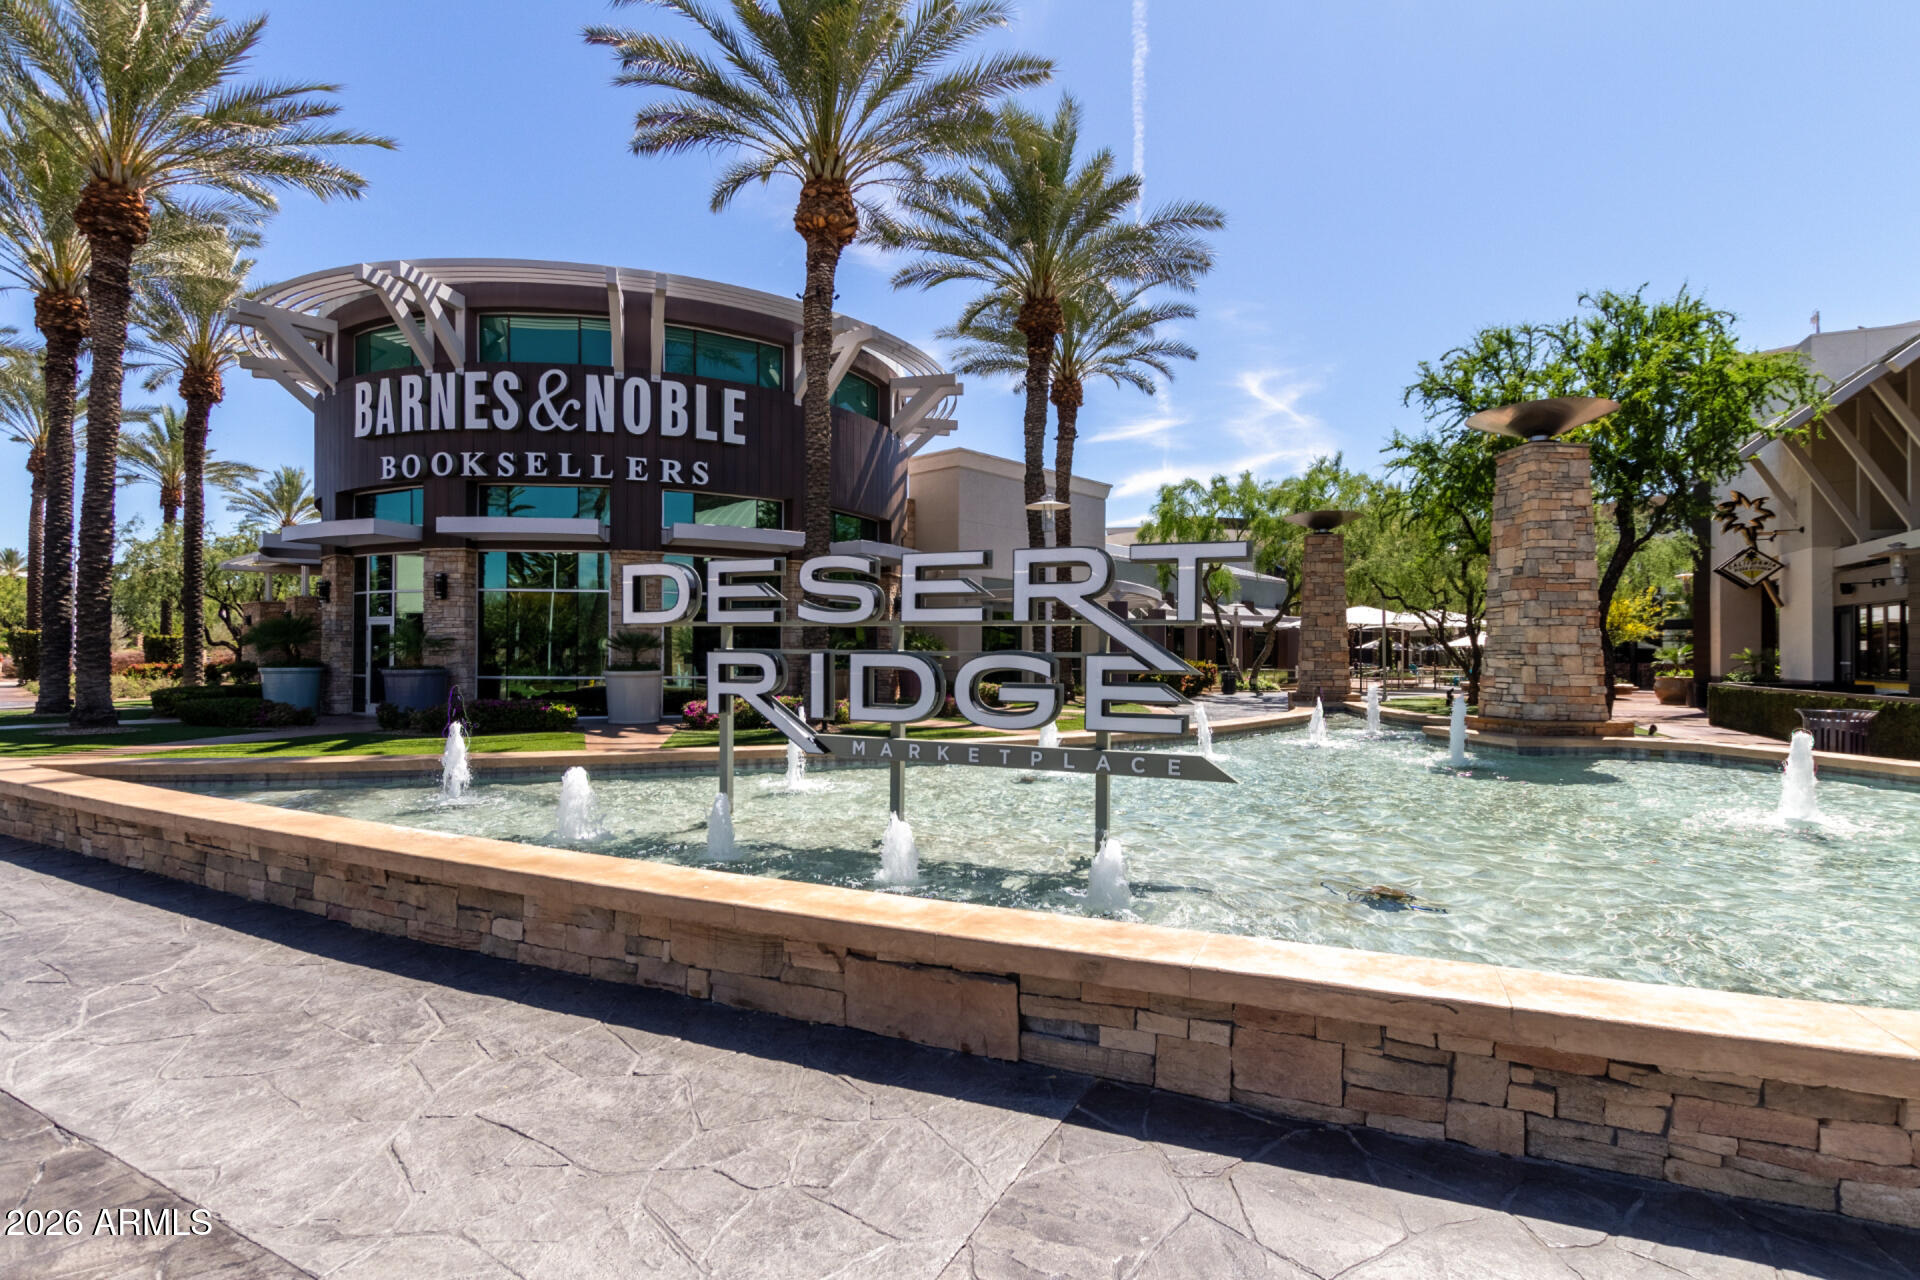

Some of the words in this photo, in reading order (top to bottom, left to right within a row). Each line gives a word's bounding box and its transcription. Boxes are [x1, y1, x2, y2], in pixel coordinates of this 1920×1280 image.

[379, 451, 710, 485] BOOKSELLERS
[1727, 560, 1777, 570] CALIIA
[622, 541, 1252, 674] DESERT
[706, 650, 1194, 754] RIDGE
[851, 740, 1182, 776] MARKETPLACE
